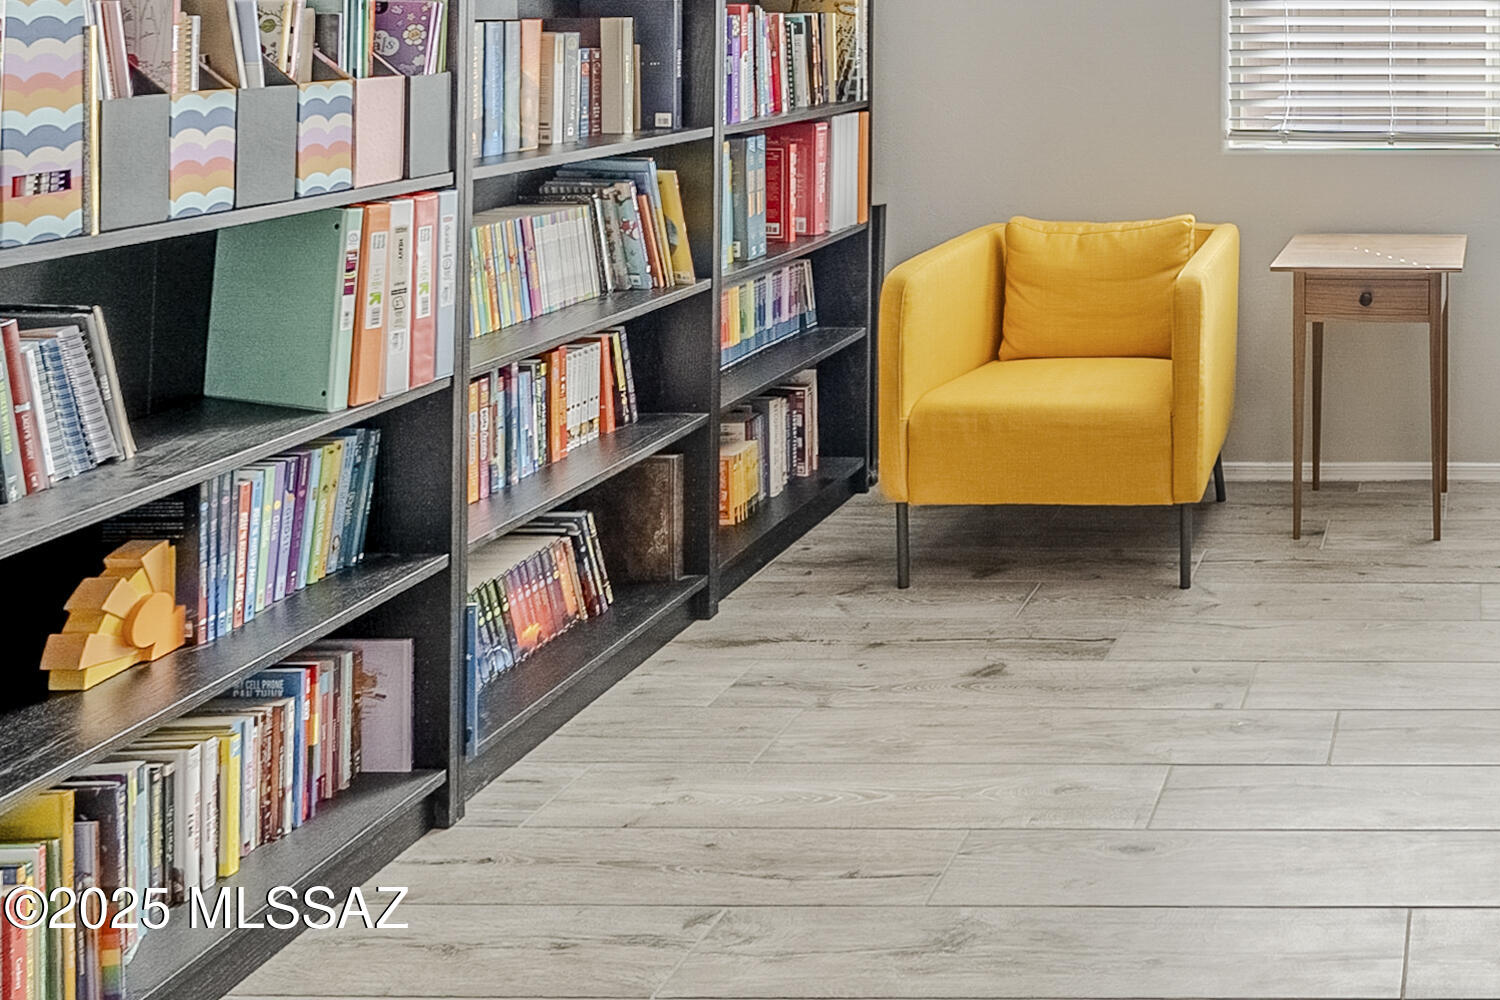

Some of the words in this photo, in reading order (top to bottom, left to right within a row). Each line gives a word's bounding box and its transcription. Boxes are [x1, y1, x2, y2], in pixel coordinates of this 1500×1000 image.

[271, 515, 281, 542] Guts
[282, 507, 292, 554] GHOSTS
[245, 679, 260, 689] CELL
[261, 679, 284, 689] PHONE
